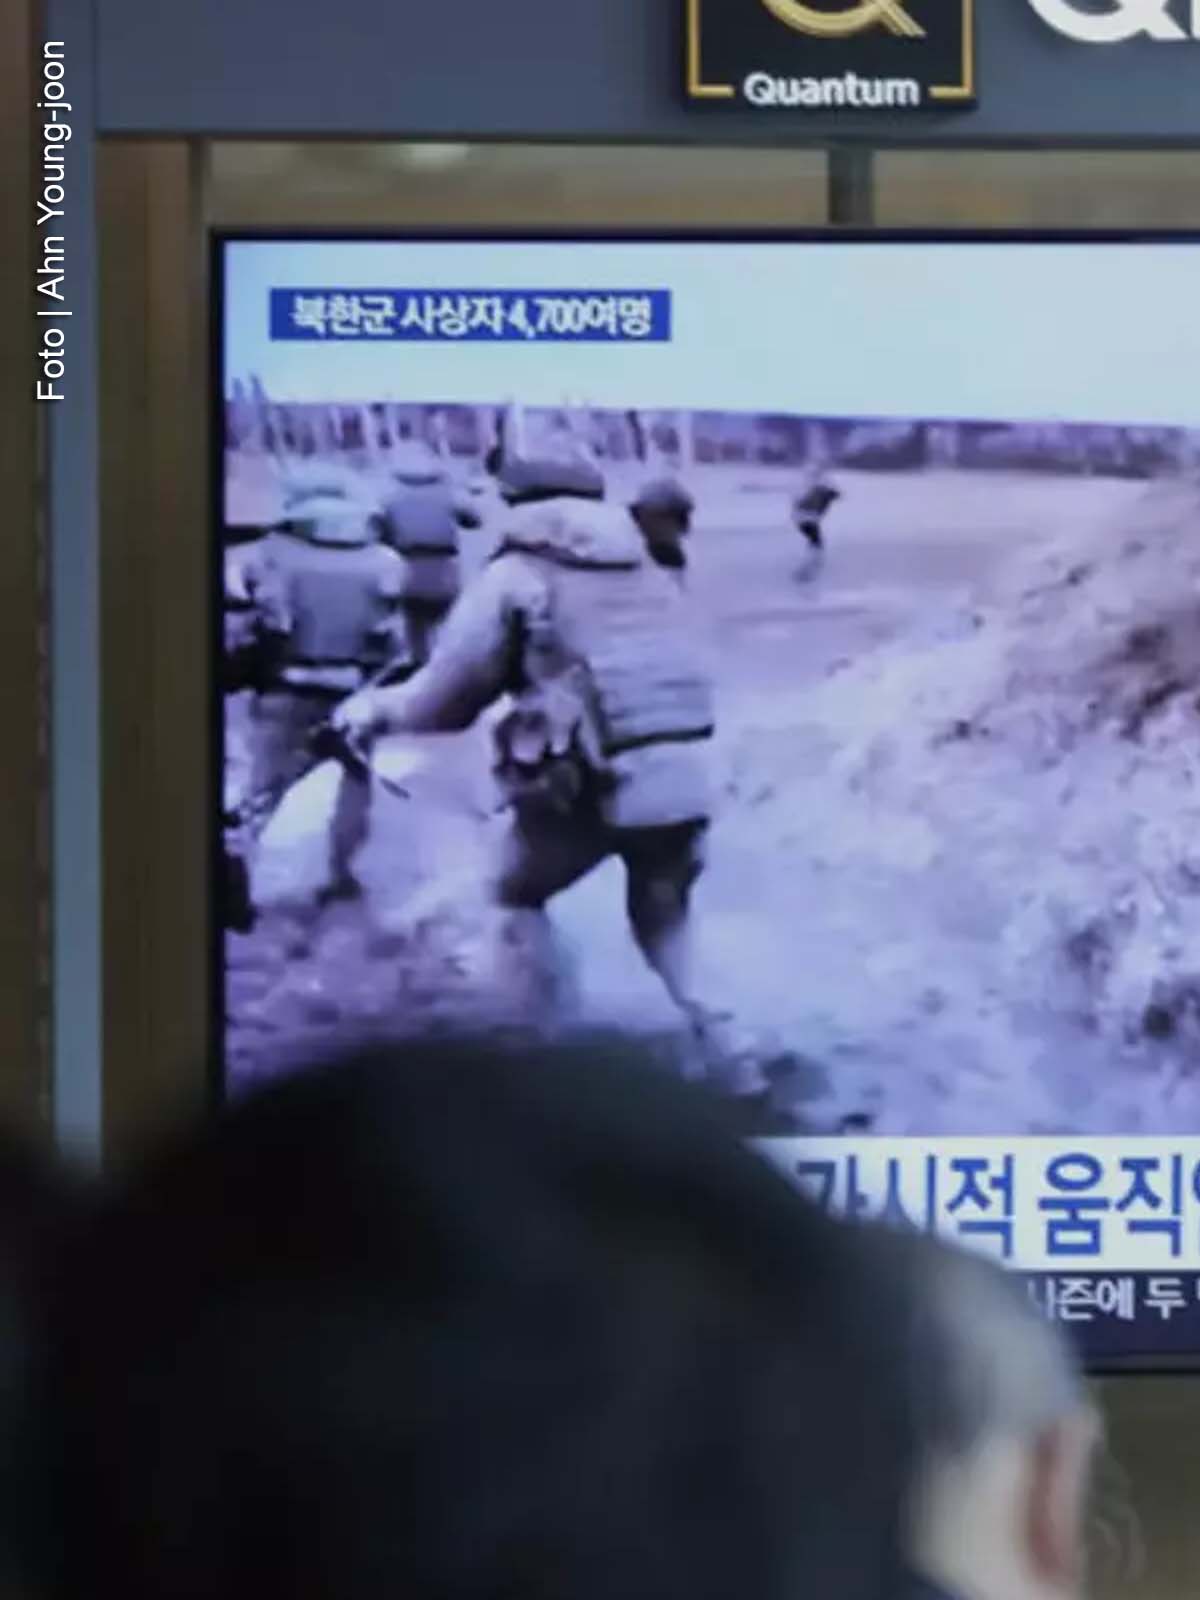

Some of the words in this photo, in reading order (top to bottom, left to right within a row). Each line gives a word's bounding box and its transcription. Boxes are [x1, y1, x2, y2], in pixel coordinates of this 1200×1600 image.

[743, 71, 920, 106] Quantum
[291, 295, 397, 335] 북한군
[400, 295, 505, 336] 사상자
[1144, 1277, 1187, 1321] 두
